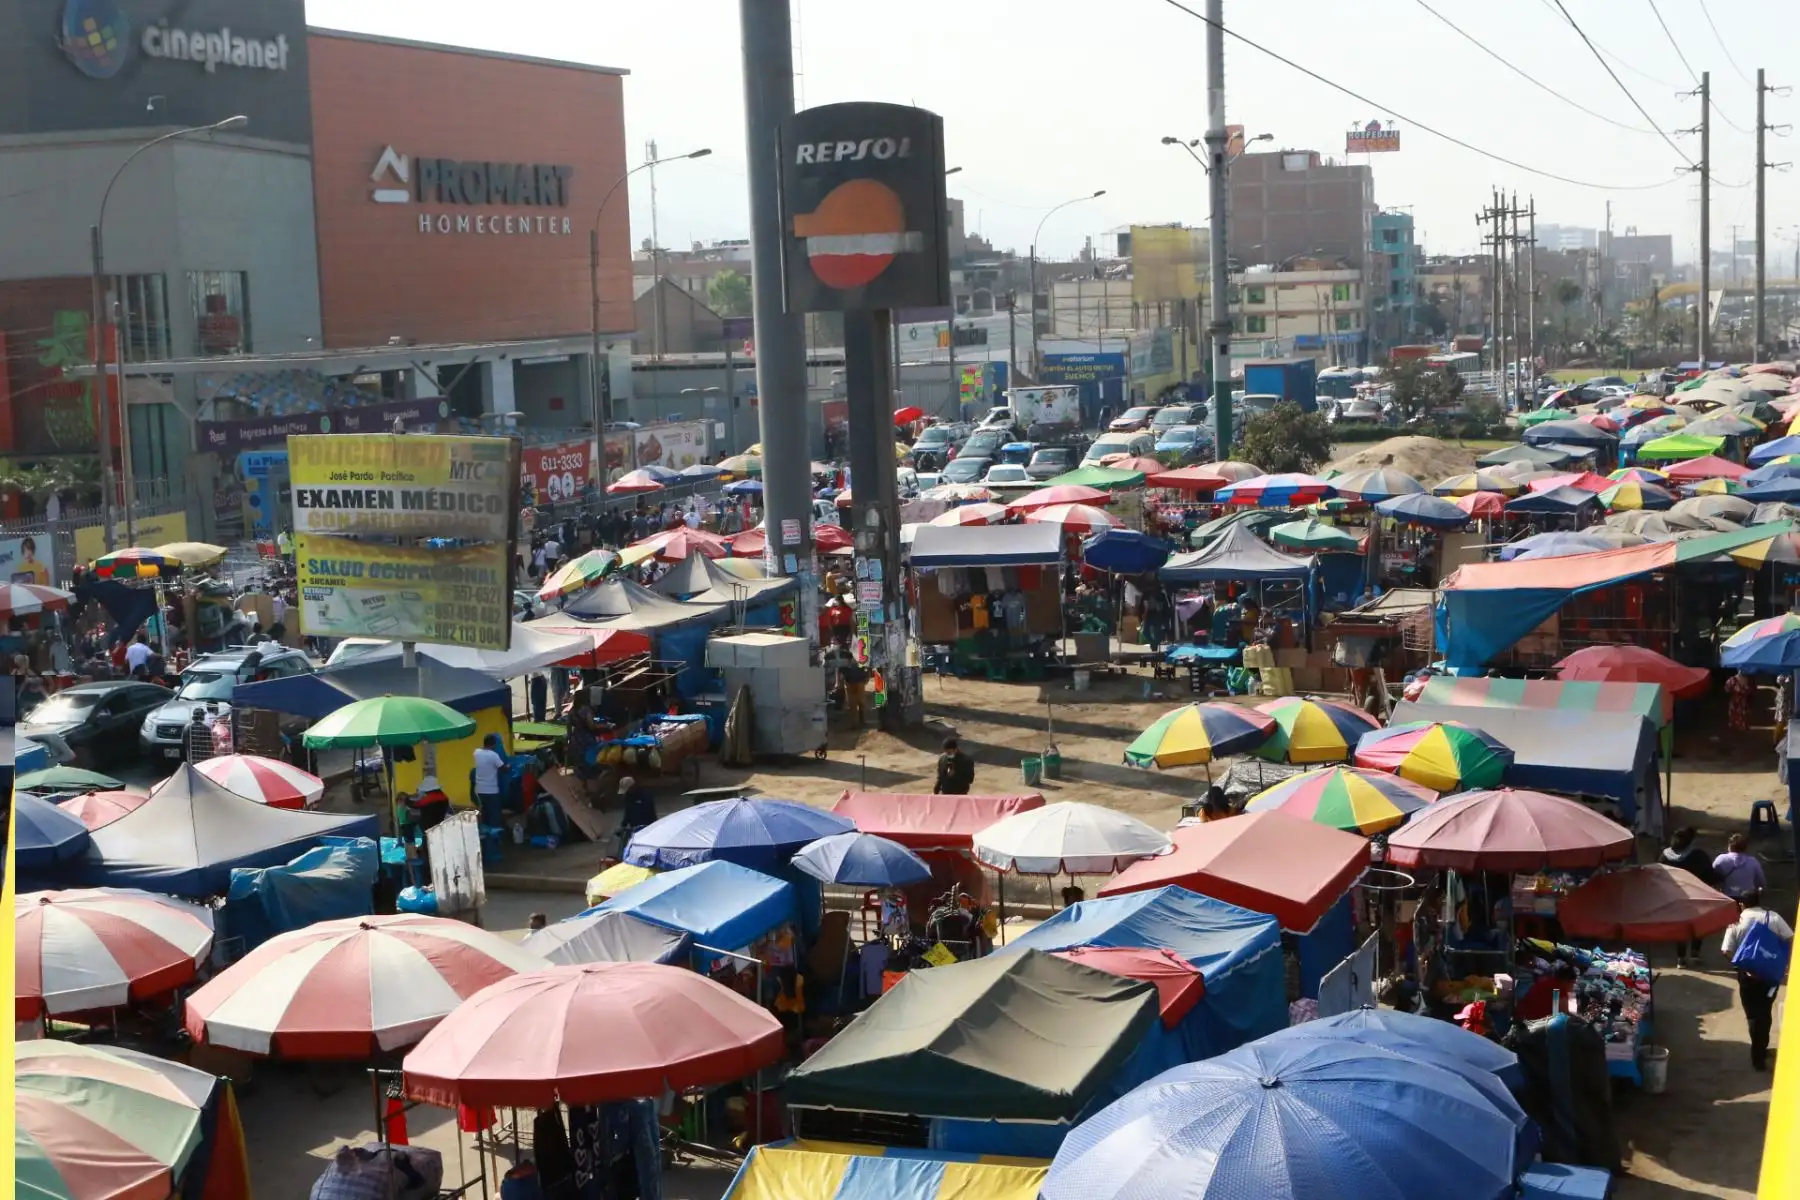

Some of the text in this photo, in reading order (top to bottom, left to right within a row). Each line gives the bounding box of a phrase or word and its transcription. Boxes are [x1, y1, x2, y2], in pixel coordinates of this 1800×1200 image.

[141, 17, 289, 73] cineplanet
[796, 137, 912, 165] REPSOL
[416, 156, 573, 207] PROMART
[418, 213, 573, 234] HOMECENTER
[449, 461, 485, 481] MTC
[541, 452, 584, 471] 611-3333
[328, 470, 348, 481] José
[350, 471, 374, 481] Pardo
[296, 487, 503, 515] EXAMEN MÉDICO
[307, 557, 364, 578] SALUD
